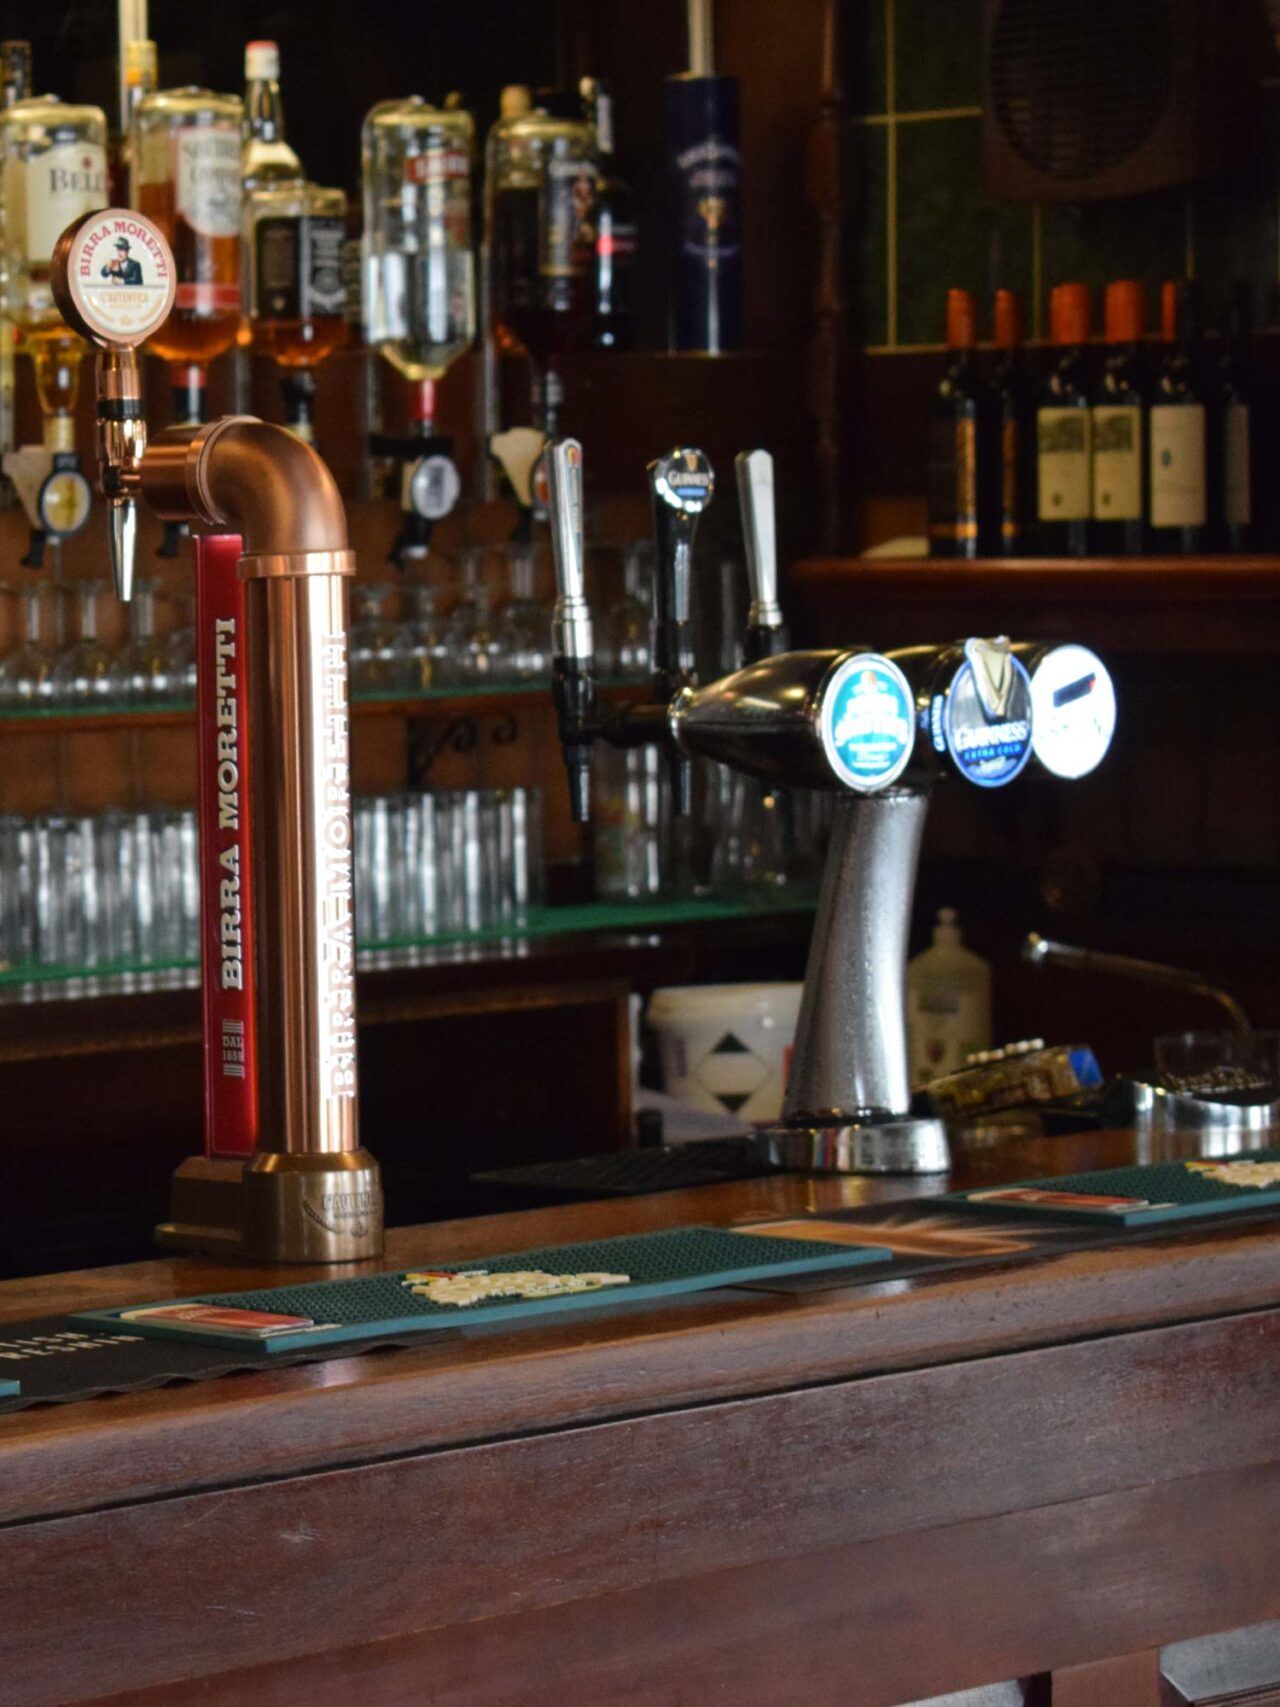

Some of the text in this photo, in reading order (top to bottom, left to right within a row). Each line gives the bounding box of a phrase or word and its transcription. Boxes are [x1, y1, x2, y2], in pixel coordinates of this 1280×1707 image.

[80, 221, 168, 278] BIRRA MORETTI
[954, 719, 1028, 752] GUINNESS
[216, 617, 244, 991] BIRRA MORETTI
